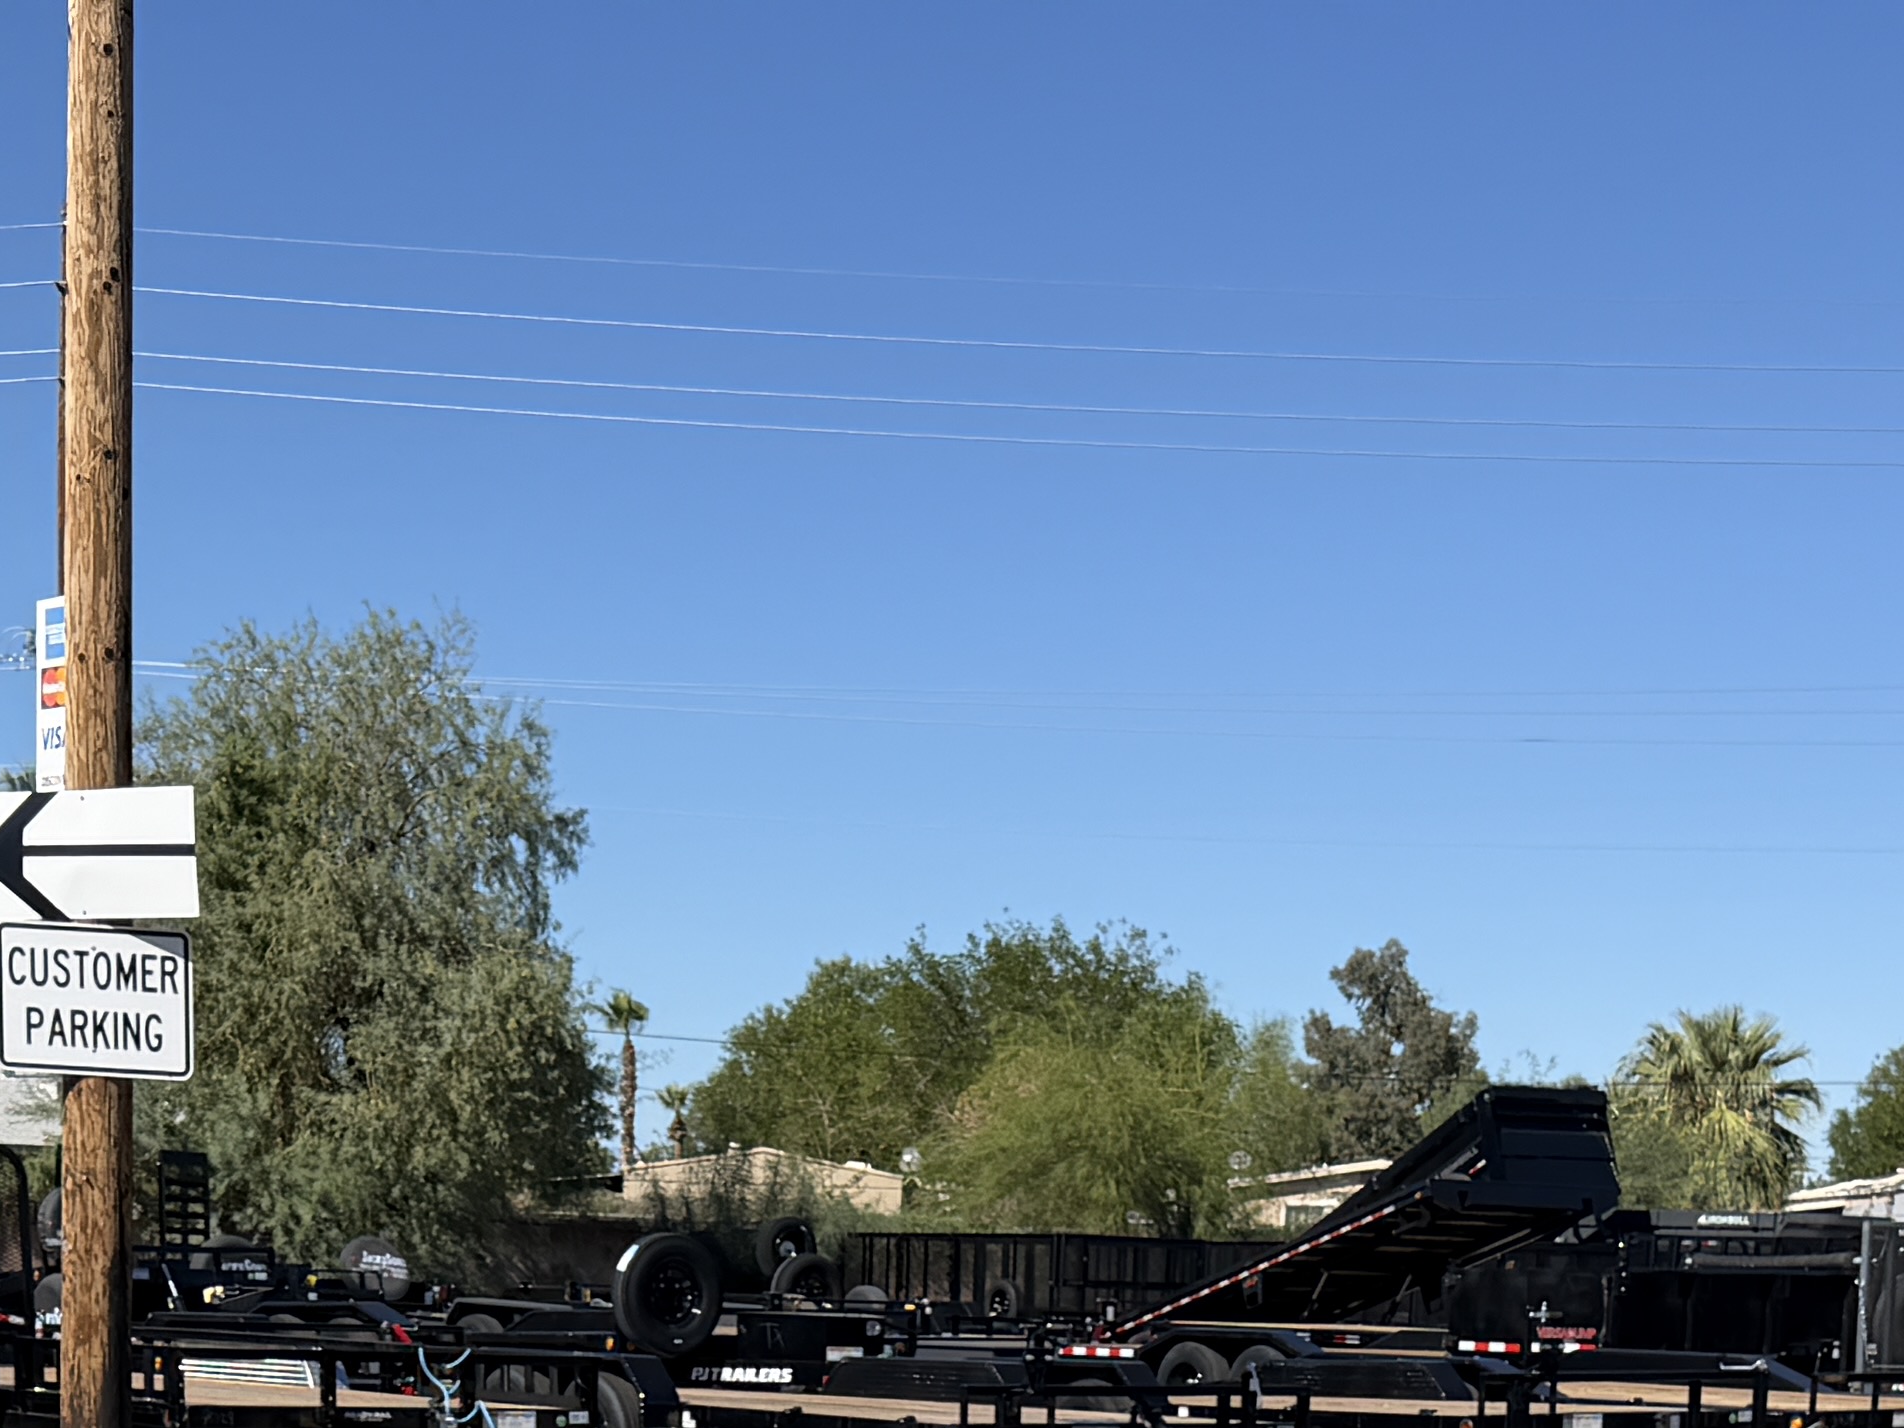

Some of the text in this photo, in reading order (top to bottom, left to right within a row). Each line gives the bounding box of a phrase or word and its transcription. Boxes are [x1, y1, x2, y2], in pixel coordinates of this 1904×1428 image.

[41, 725, 66, 751] VIS
[8, 945, 179, 995] CUSTOMER
[26, 1006, 164, 1053] PARKING
